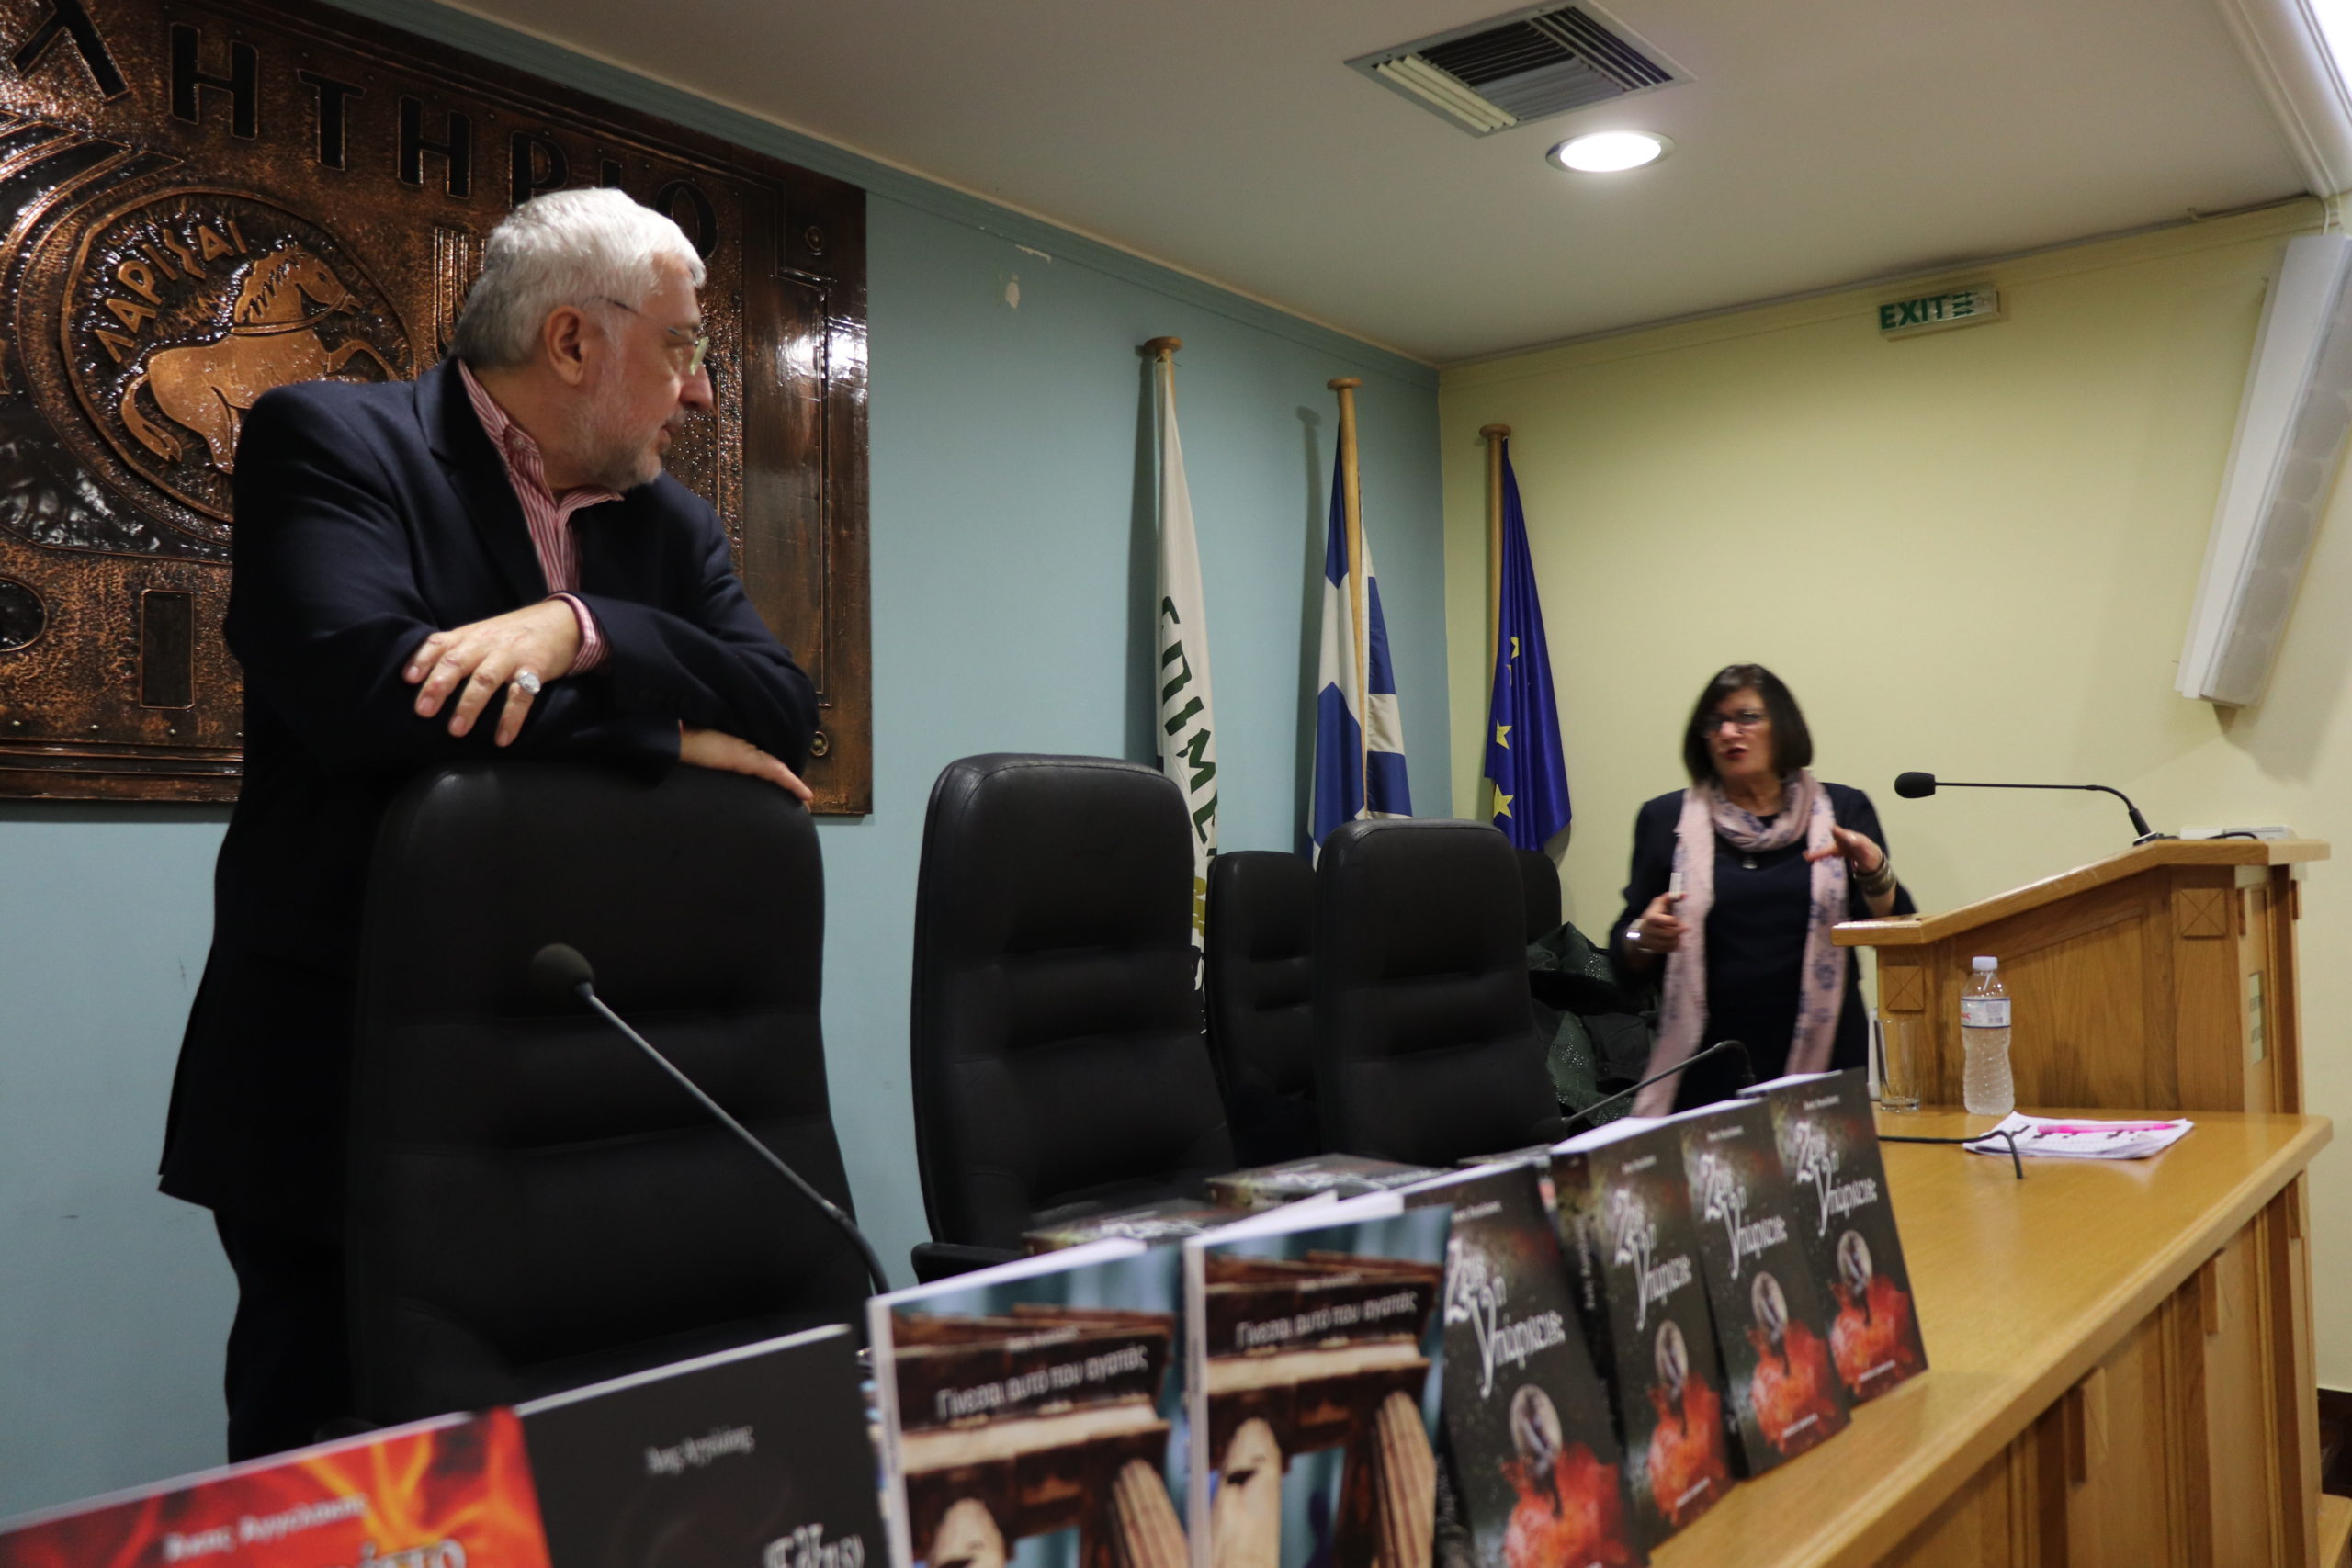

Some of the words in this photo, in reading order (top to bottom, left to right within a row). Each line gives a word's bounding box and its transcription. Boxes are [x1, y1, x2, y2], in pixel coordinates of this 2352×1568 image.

[1880, 293, 1949, 330] EXIT
[1332, 1303, 1363, 1325] που
[1048, 1360, 1084, 1390] που
